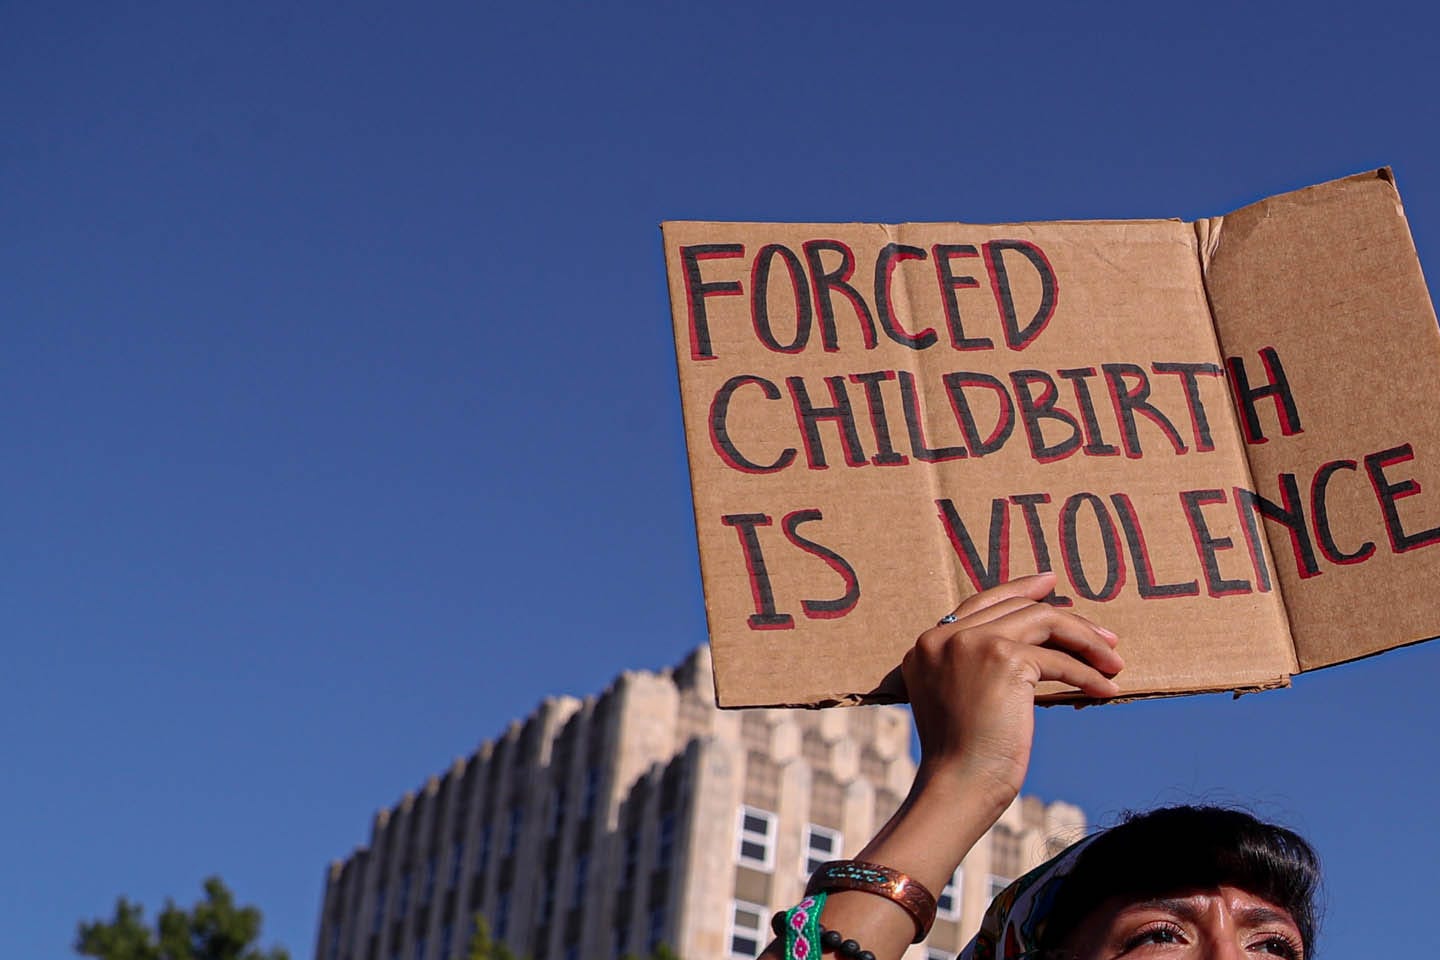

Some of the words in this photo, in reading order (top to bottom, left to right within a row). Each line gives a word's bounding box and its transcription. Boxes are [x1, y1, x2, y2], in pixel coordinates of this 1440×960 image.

[679, 238, 1059, 361] FORCED
[708, 346, 1304, 475] CHILDBIRTH
[721, 508, 860, 631] IS
